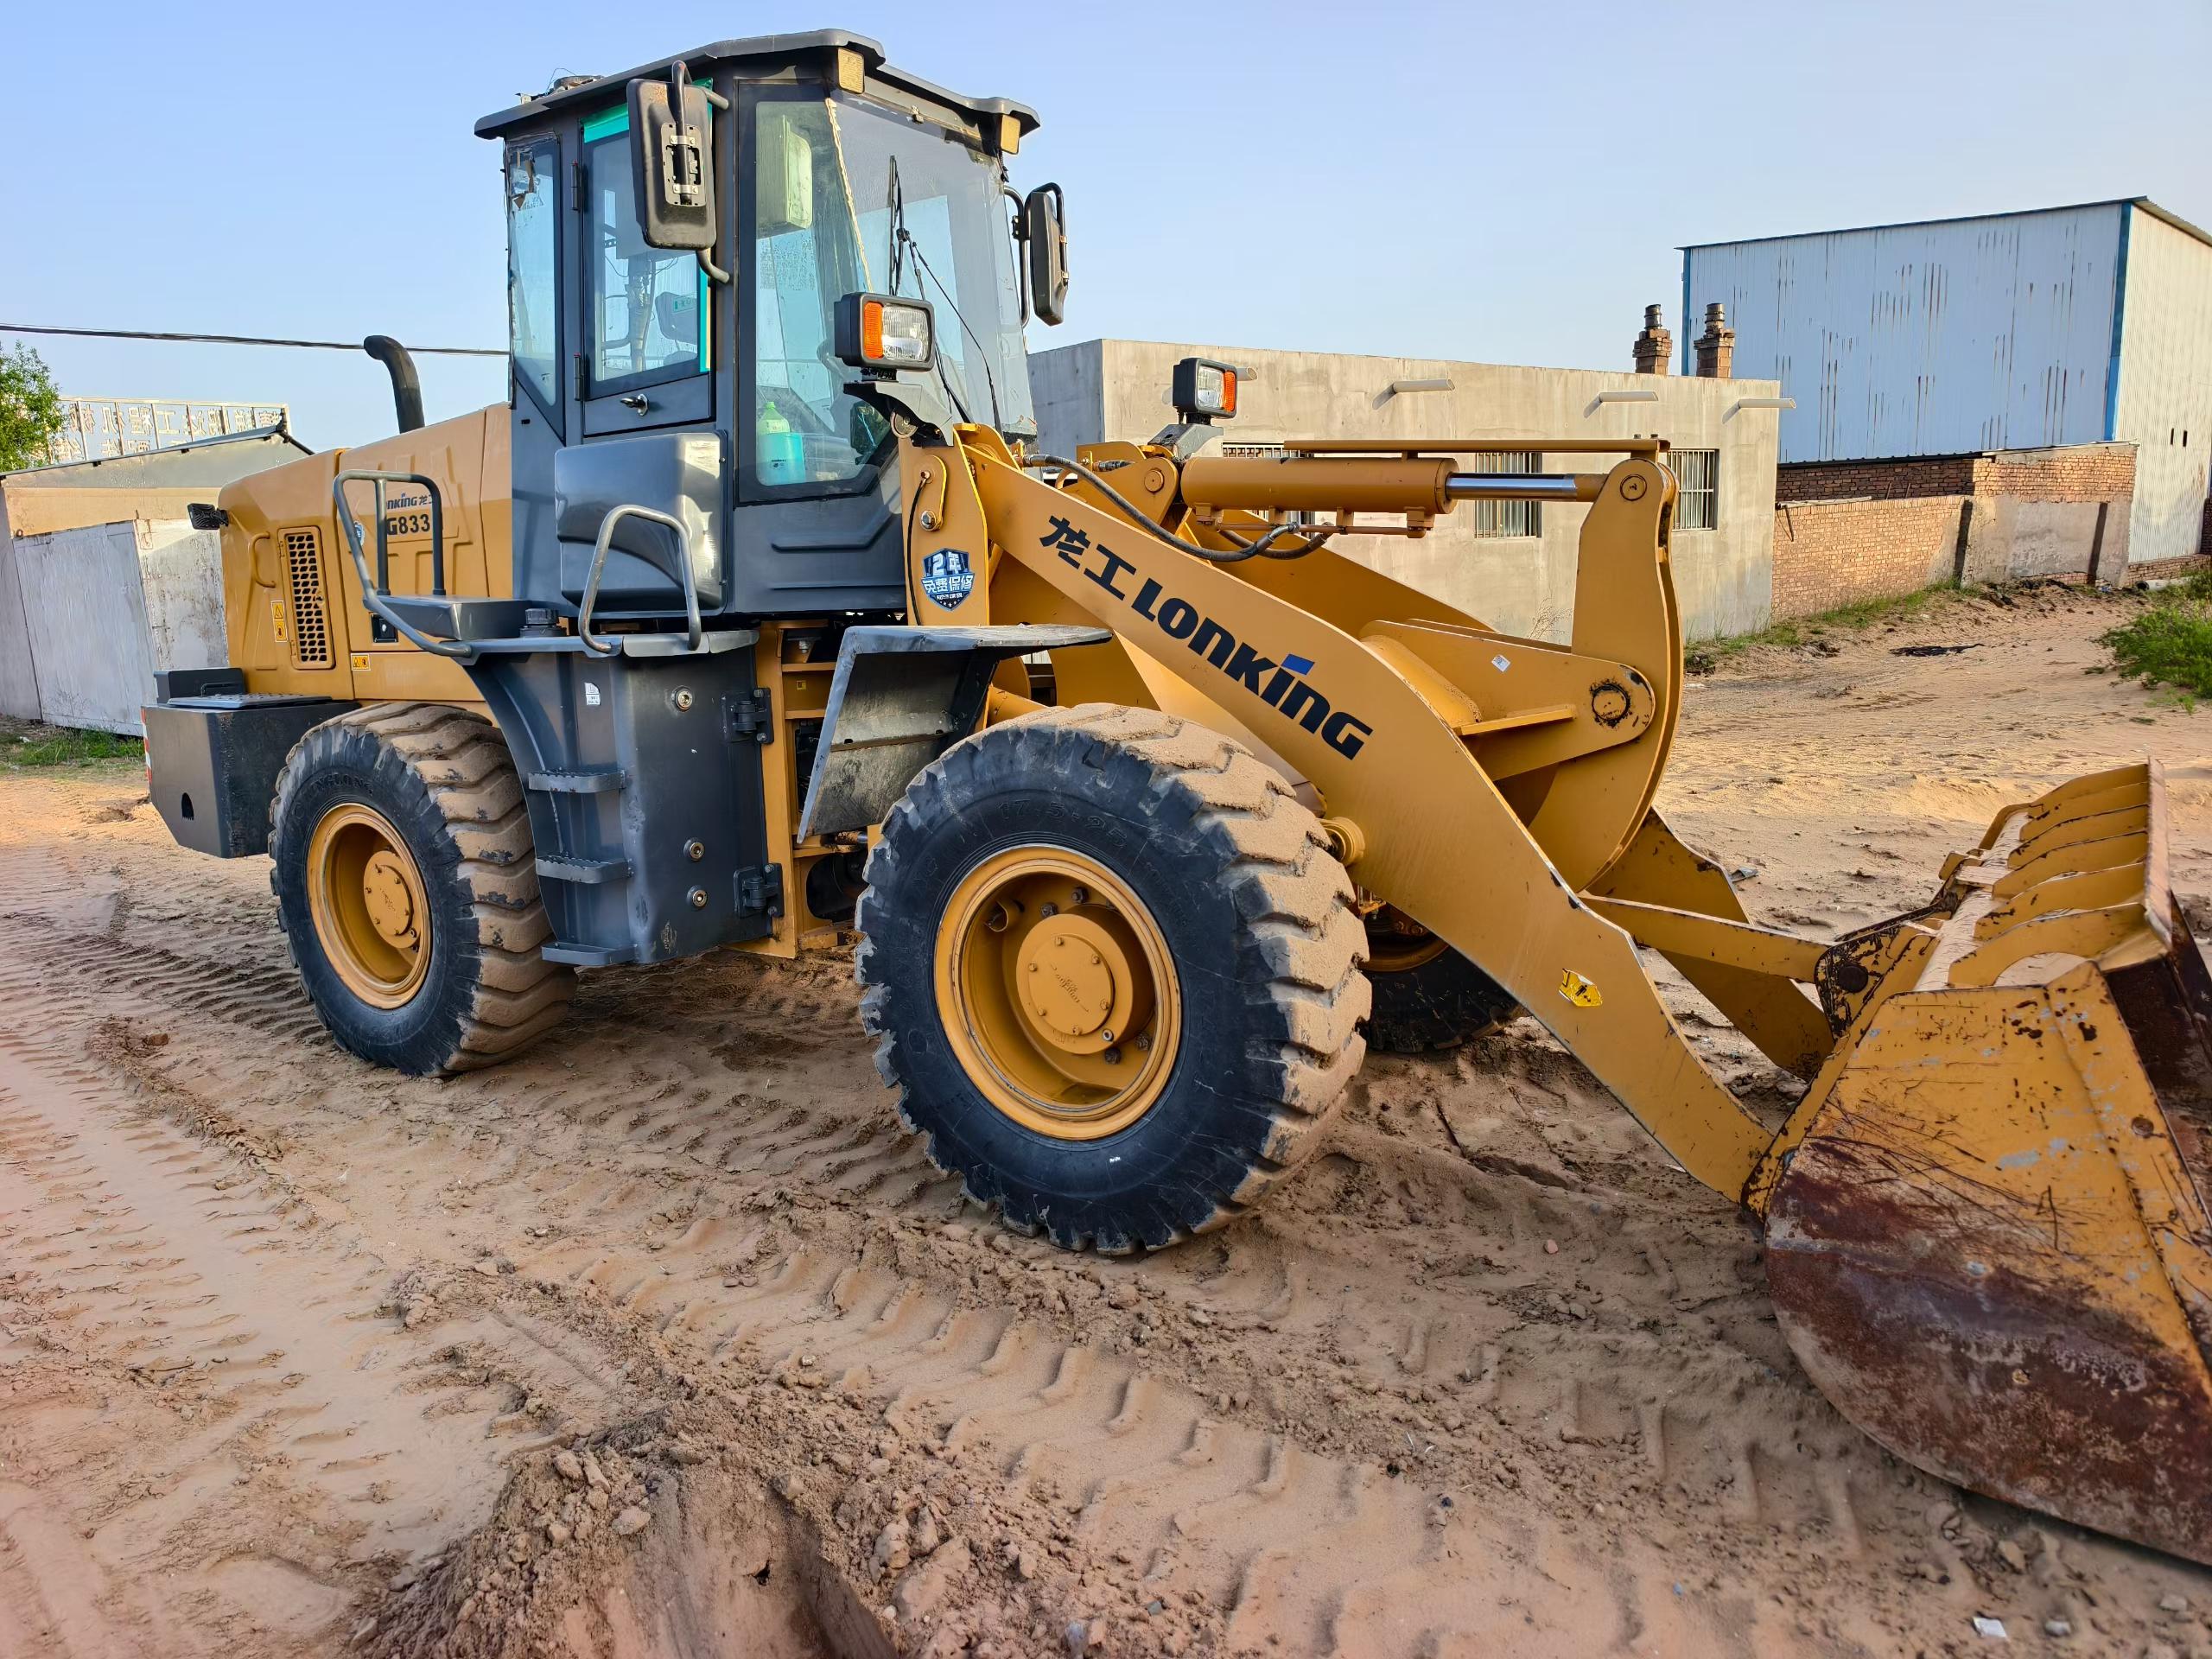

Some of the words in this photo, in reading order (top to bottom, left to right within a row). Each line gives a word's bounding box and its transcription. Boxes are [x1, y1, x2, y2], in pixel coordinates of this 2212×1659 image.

[386, 513, 430, 535] G833
[932, 551, 962, 575] 2年
[1039, 516, 1137, 601] 龙工
[922, 575, 974, 594] 免费保修
